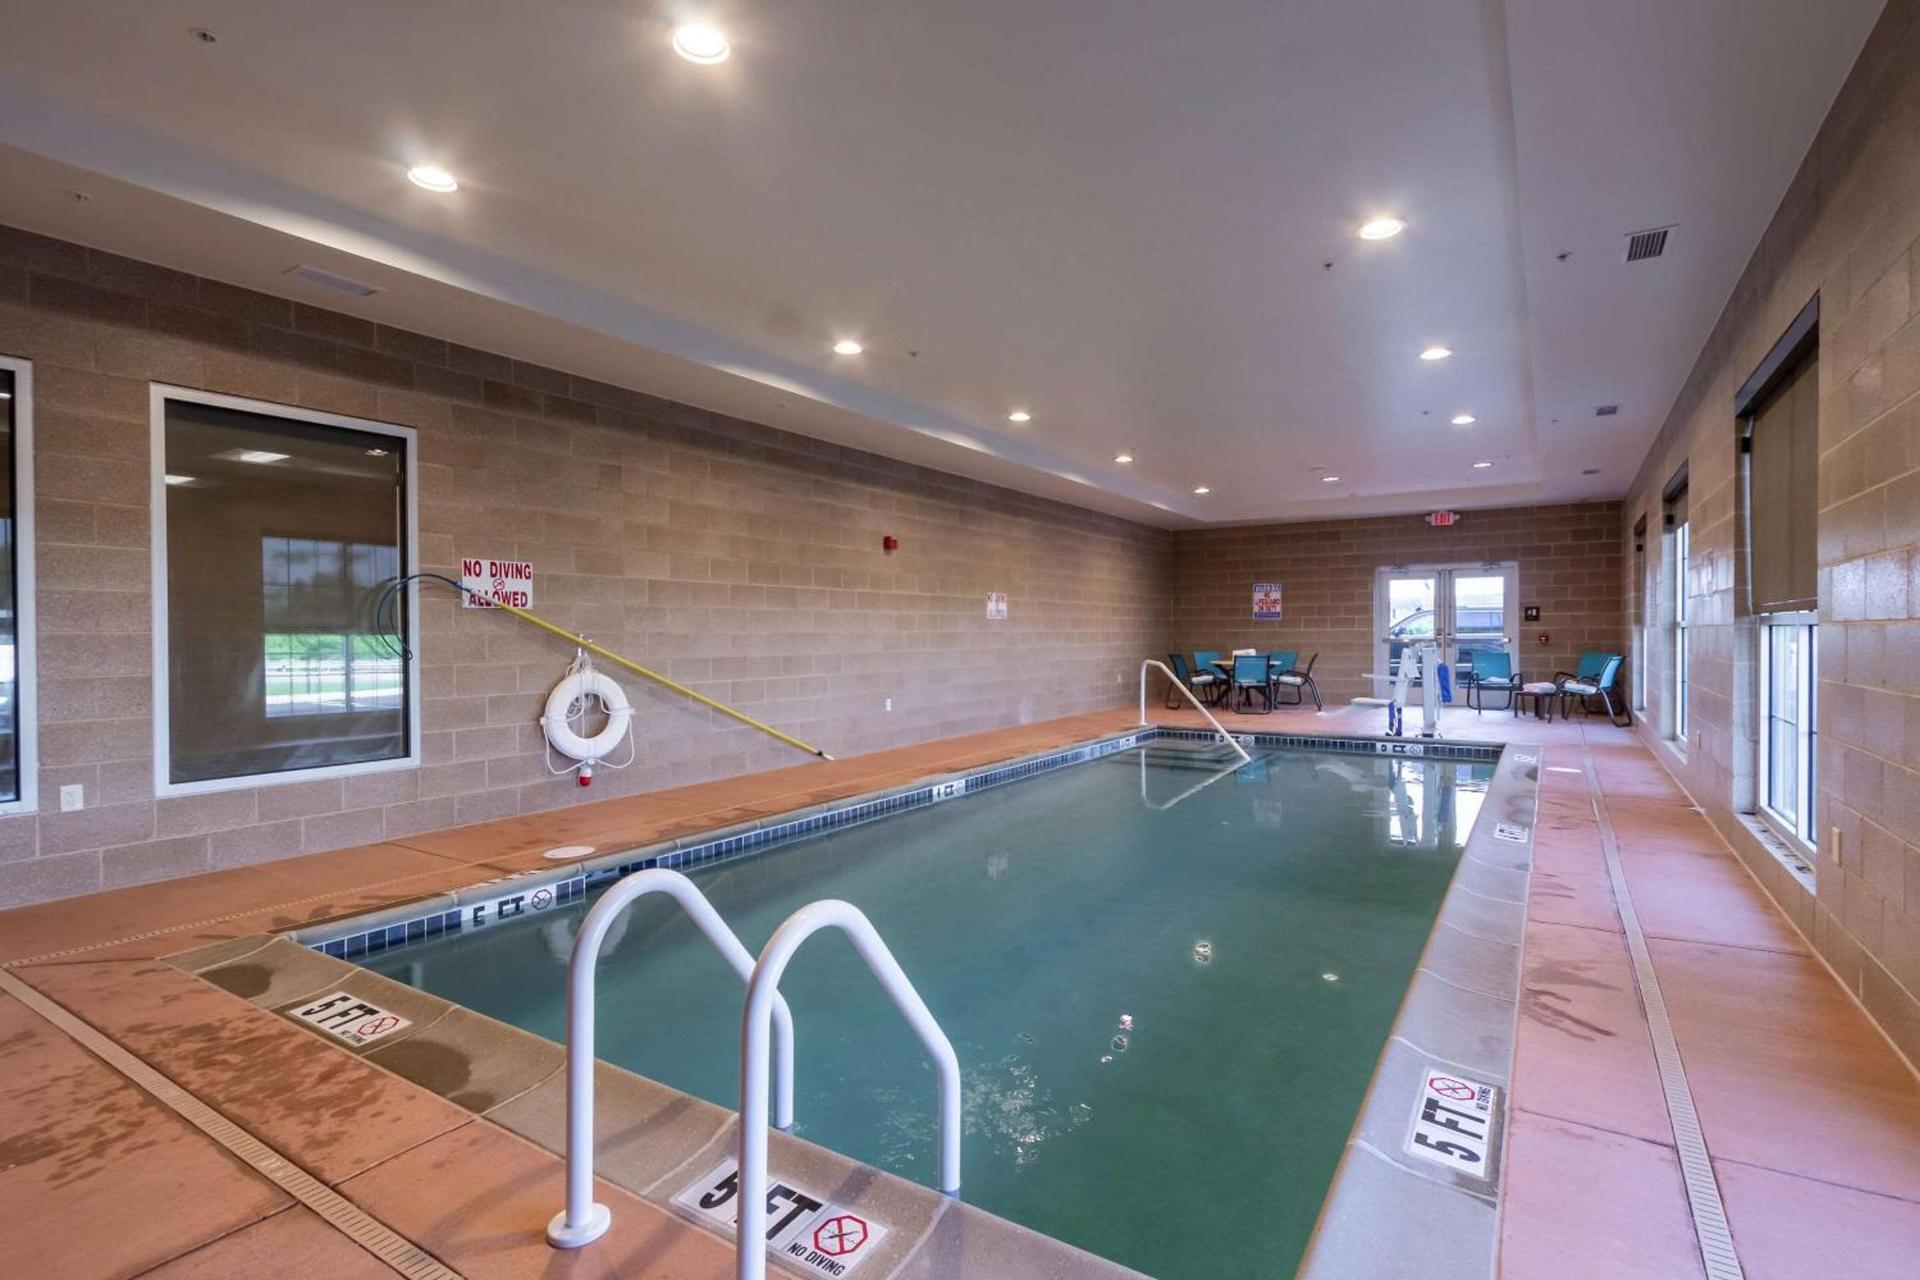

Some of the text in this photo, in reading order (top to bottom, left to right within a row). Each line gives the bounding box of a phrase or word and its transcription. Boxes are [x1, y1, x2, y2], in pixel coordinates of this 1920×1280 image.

[463, 560, 532, 580] NO DIVING
[300, 995, 381, 1029] 5 FT
[1414, 1097, 1486, 1163] 5 FT
[787, 1242, 846, 1277] NO DIVING
